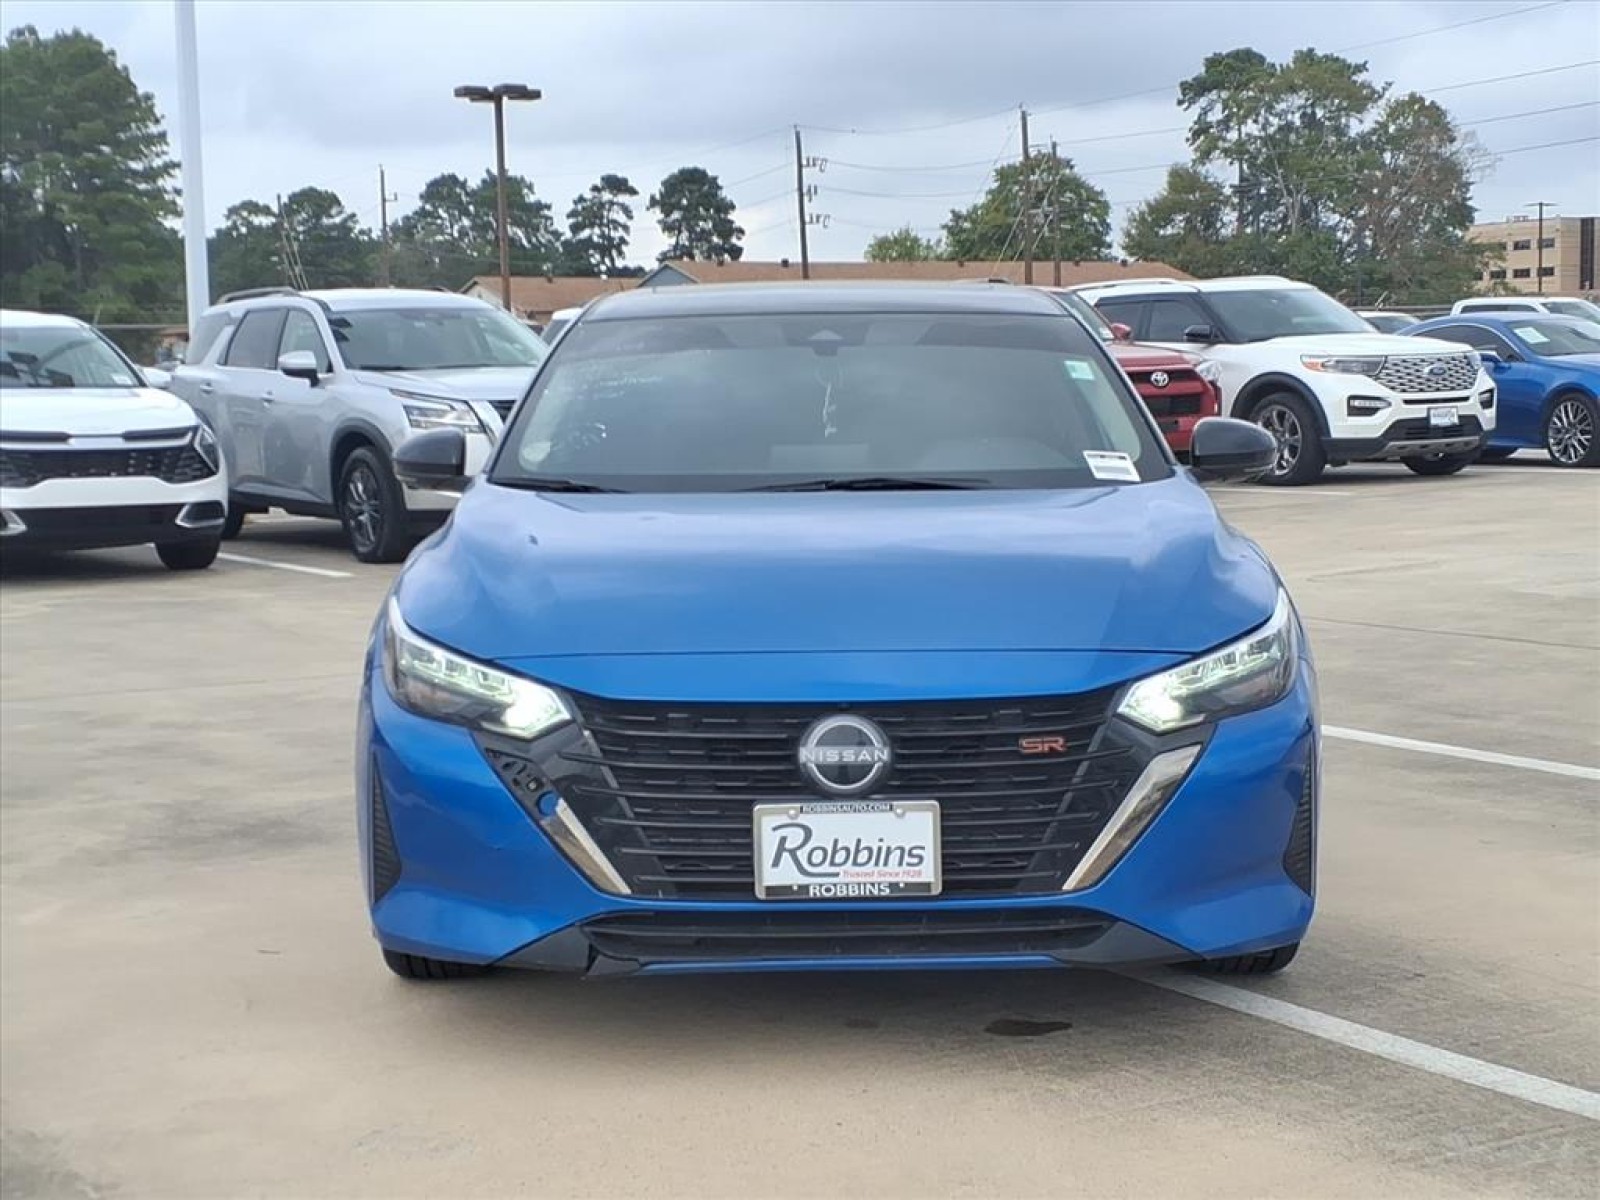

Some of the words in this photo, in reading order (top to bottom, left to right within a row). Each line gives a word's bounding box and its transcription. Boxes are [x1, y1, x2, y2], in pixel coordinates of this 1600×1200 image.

[1020, 737, 1065, 754] SR
[800, 749, 888, 763] NISSAN
[803, 803, 889, 814] ROBBINSAUTO.COM
[771, 823, 926, 878] Robbins
[843, 870, 875, 878] Trusted
[878, 870, 900, 878] Since
[809, 883, 890, 897] ROBBINS
